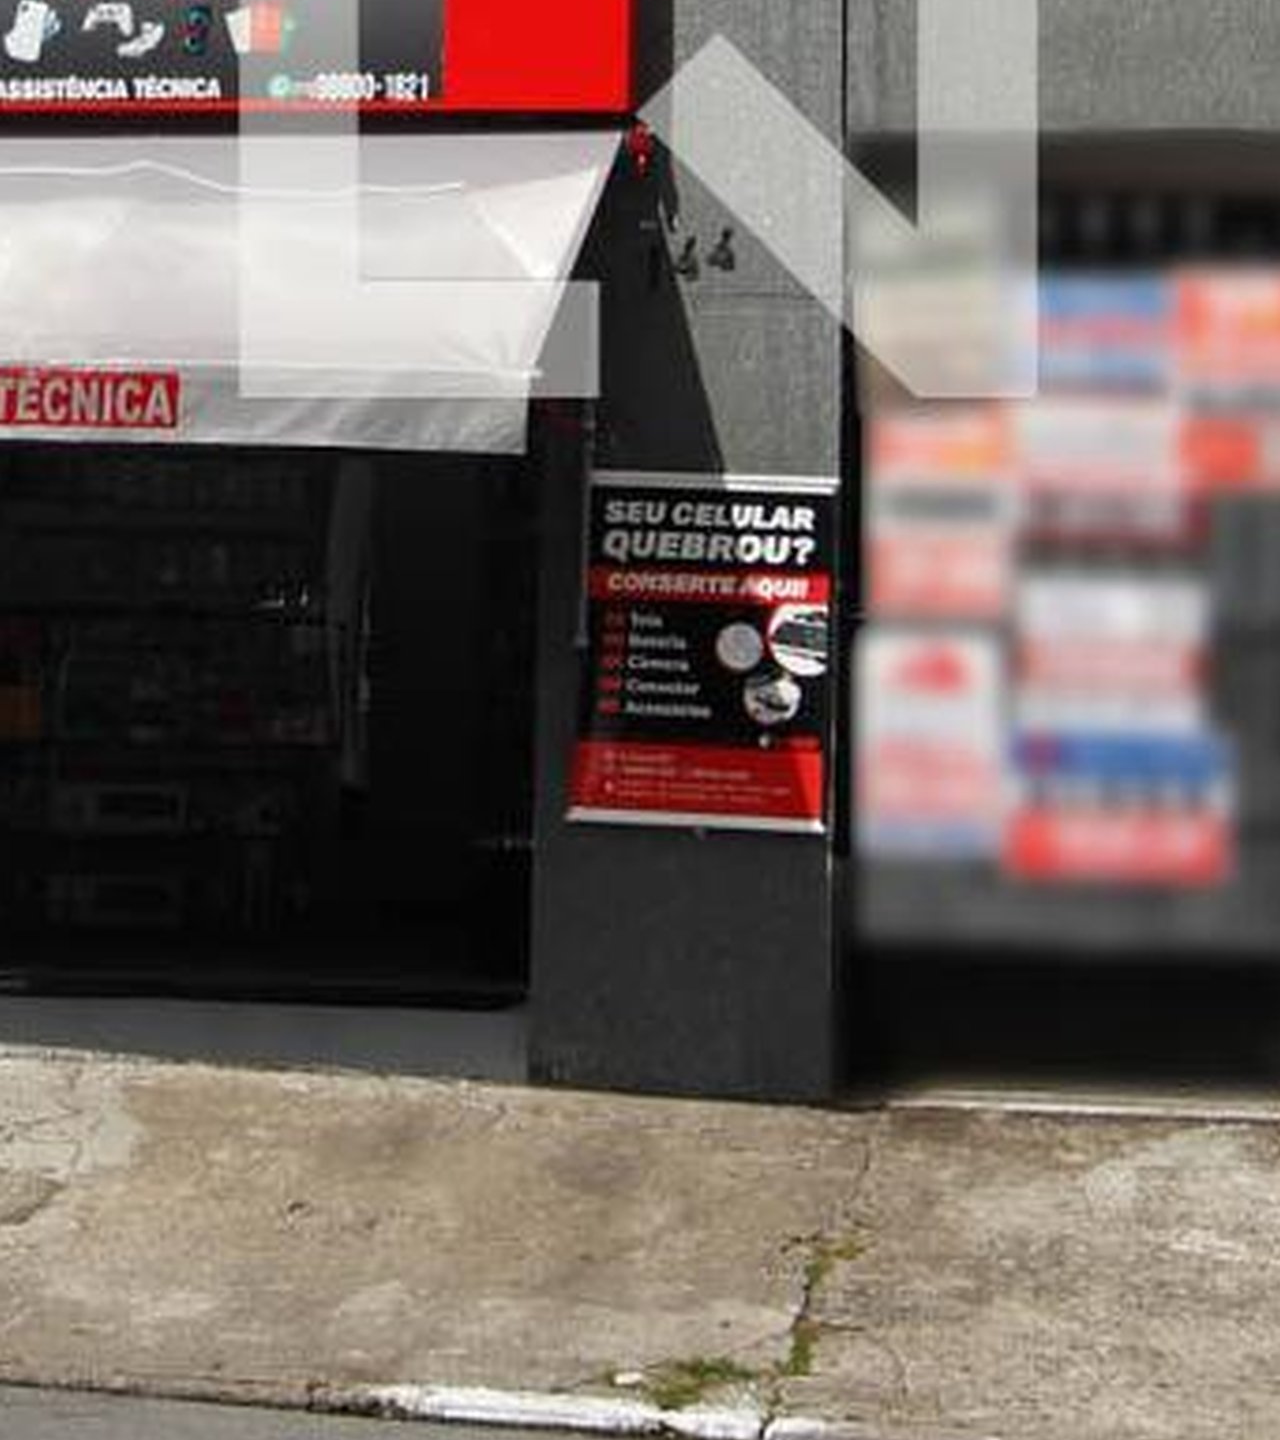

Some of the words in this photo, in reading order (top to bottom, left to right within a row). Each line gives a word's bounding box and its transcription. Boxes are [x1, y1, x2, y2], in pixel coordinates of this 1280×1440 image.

[604, 501, 666, 525] SEU
[672, 502, 814, 531] CELULAR
[603, 530, 814, 565] QUEBROU?
